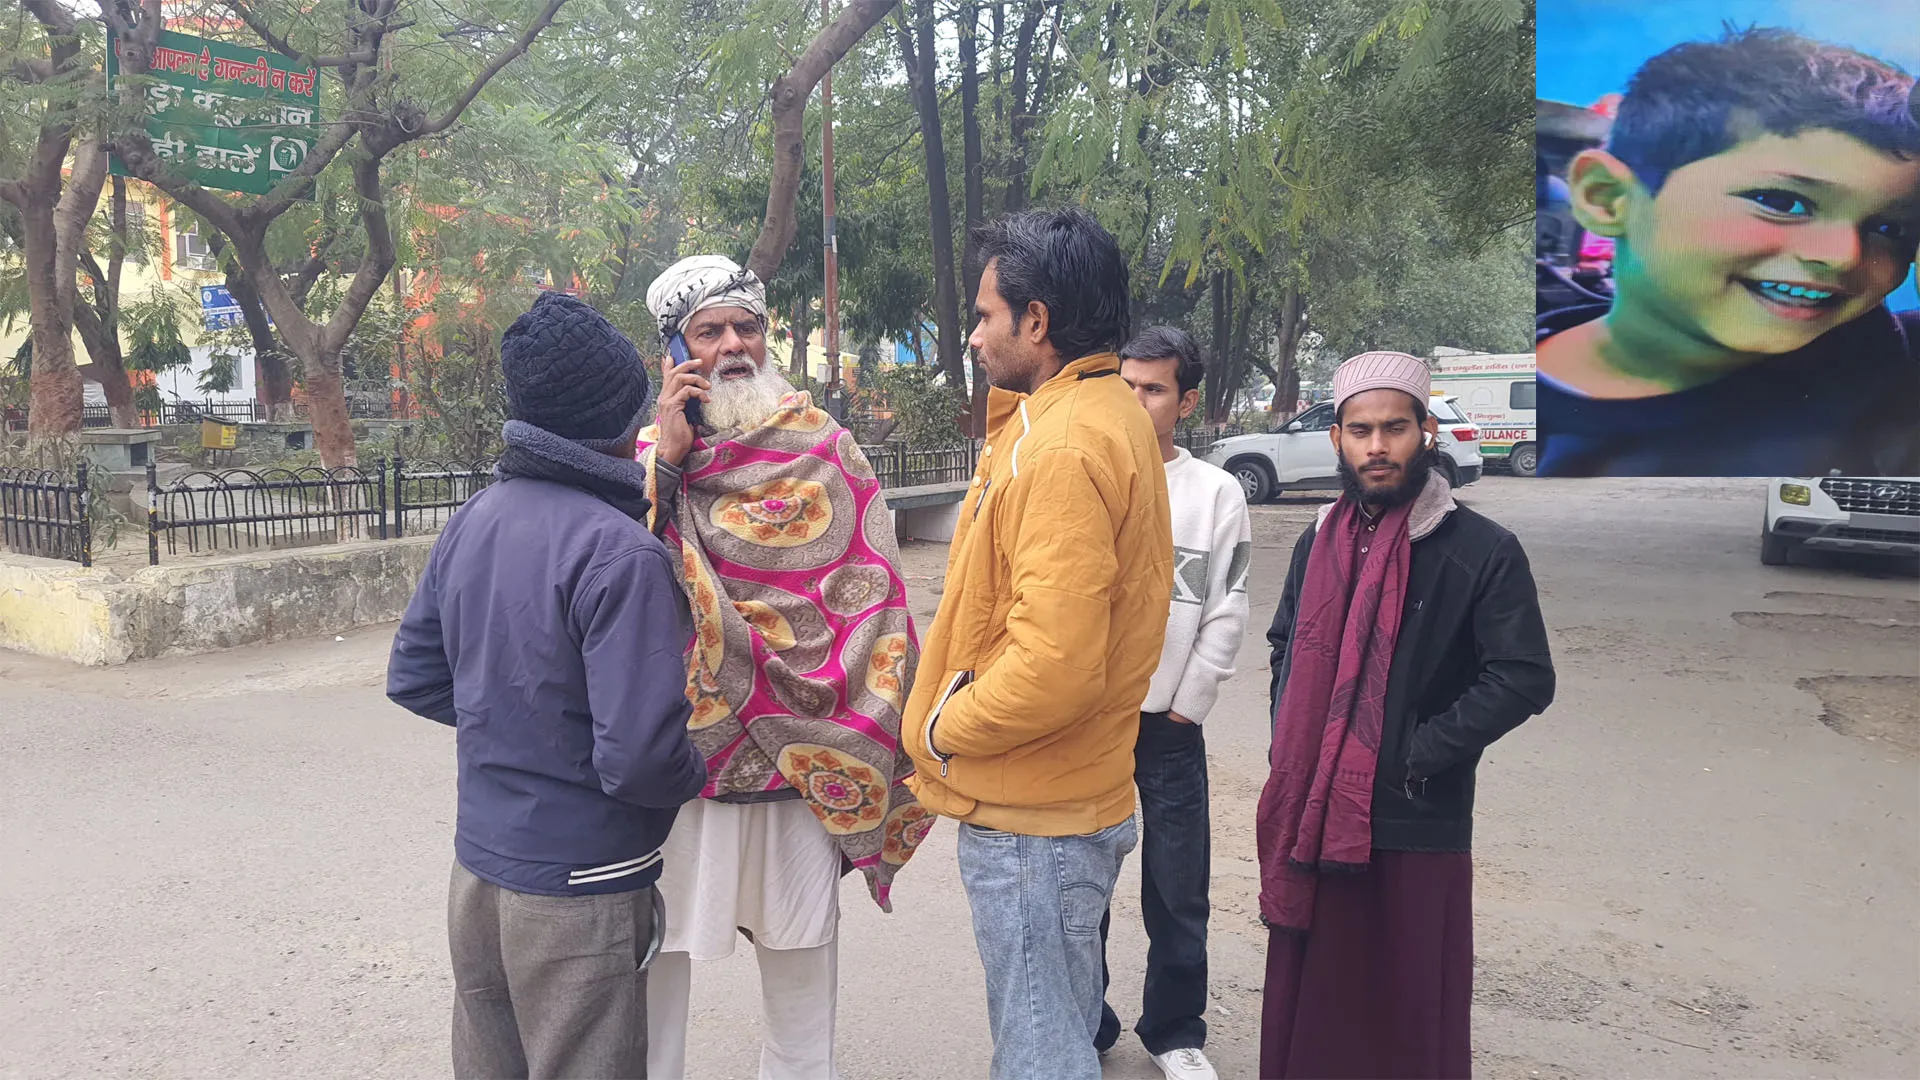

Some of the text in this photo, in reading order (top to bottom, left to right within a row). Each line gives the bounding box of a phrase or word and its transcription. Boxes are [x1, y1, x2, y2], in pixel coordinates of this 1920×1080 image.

[149, 46, 197, 76] आपका
[199, 45, 211, 81] है
[271, 67, 286, 92] न
[288, 66, 317, 97] करें
